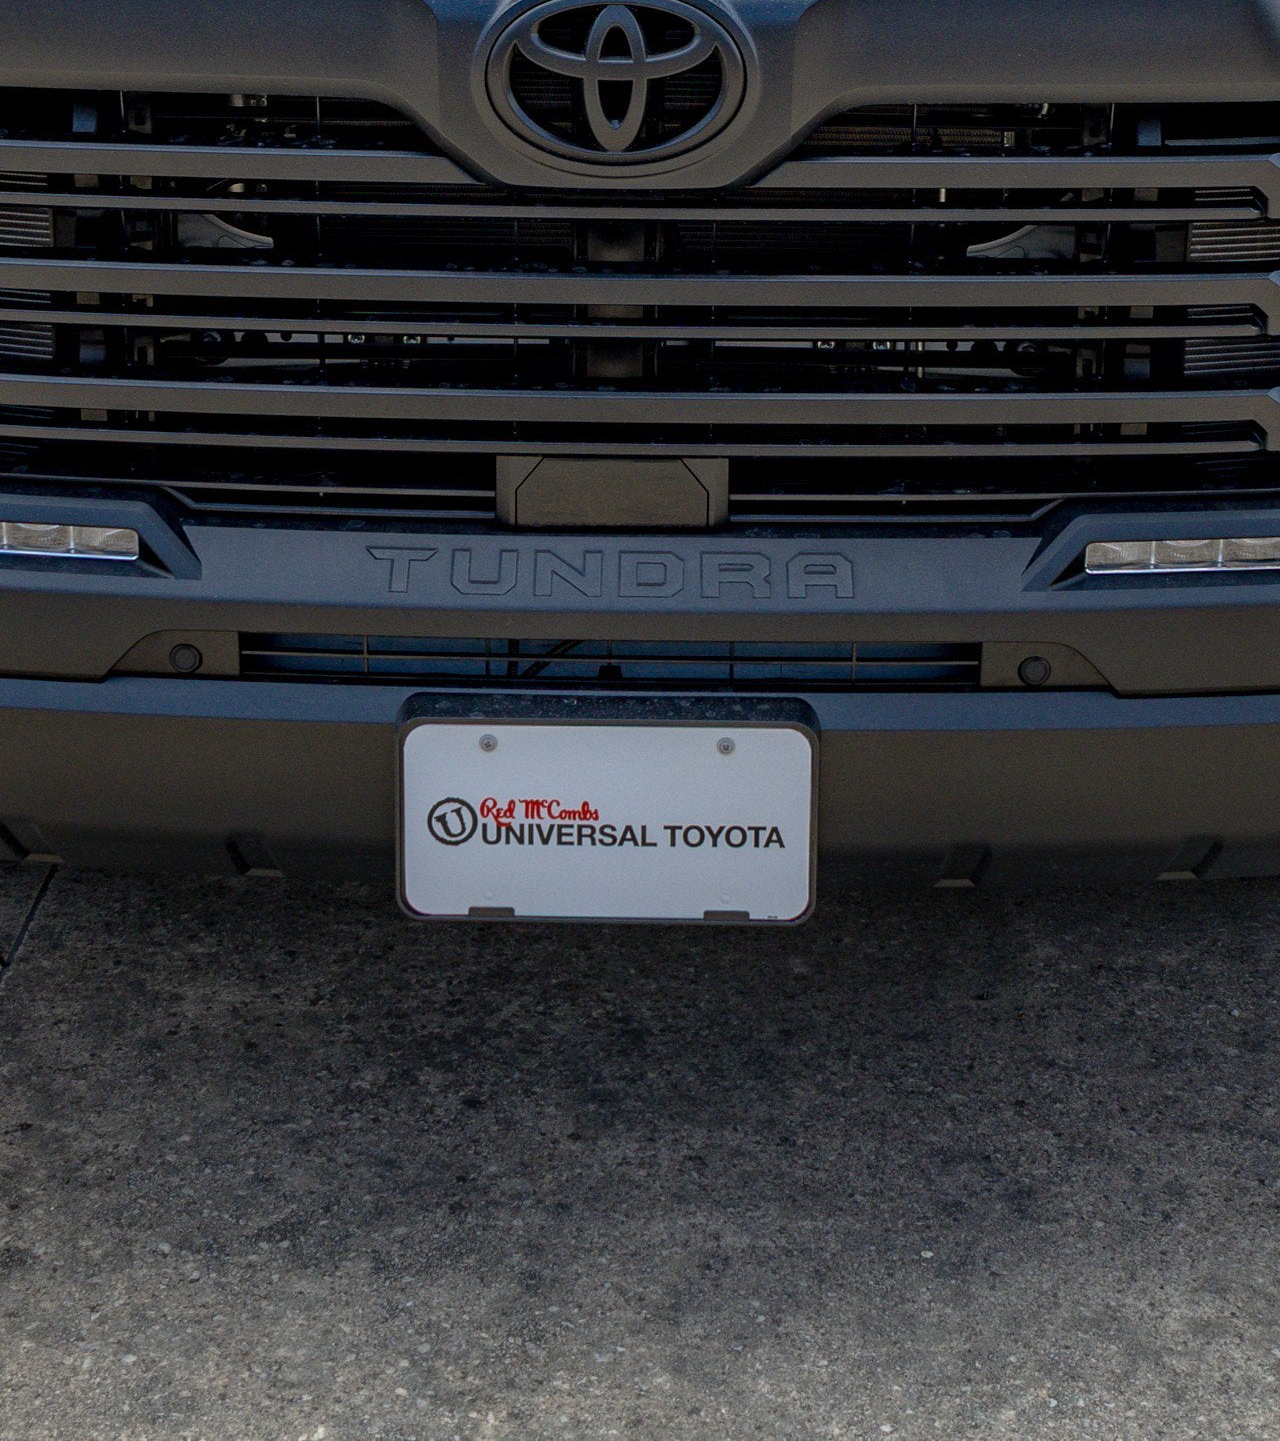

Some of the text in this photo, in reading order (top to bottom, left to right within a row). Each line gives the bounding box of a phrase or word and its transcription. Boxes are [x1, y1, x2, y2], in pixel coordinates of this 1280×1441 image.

[365, 545, 855, 600] TUNDRA
[480, 797, 600, 827] Red McCombs
[481, 823, 785, 848] UNIVERSAL TOYOTA
